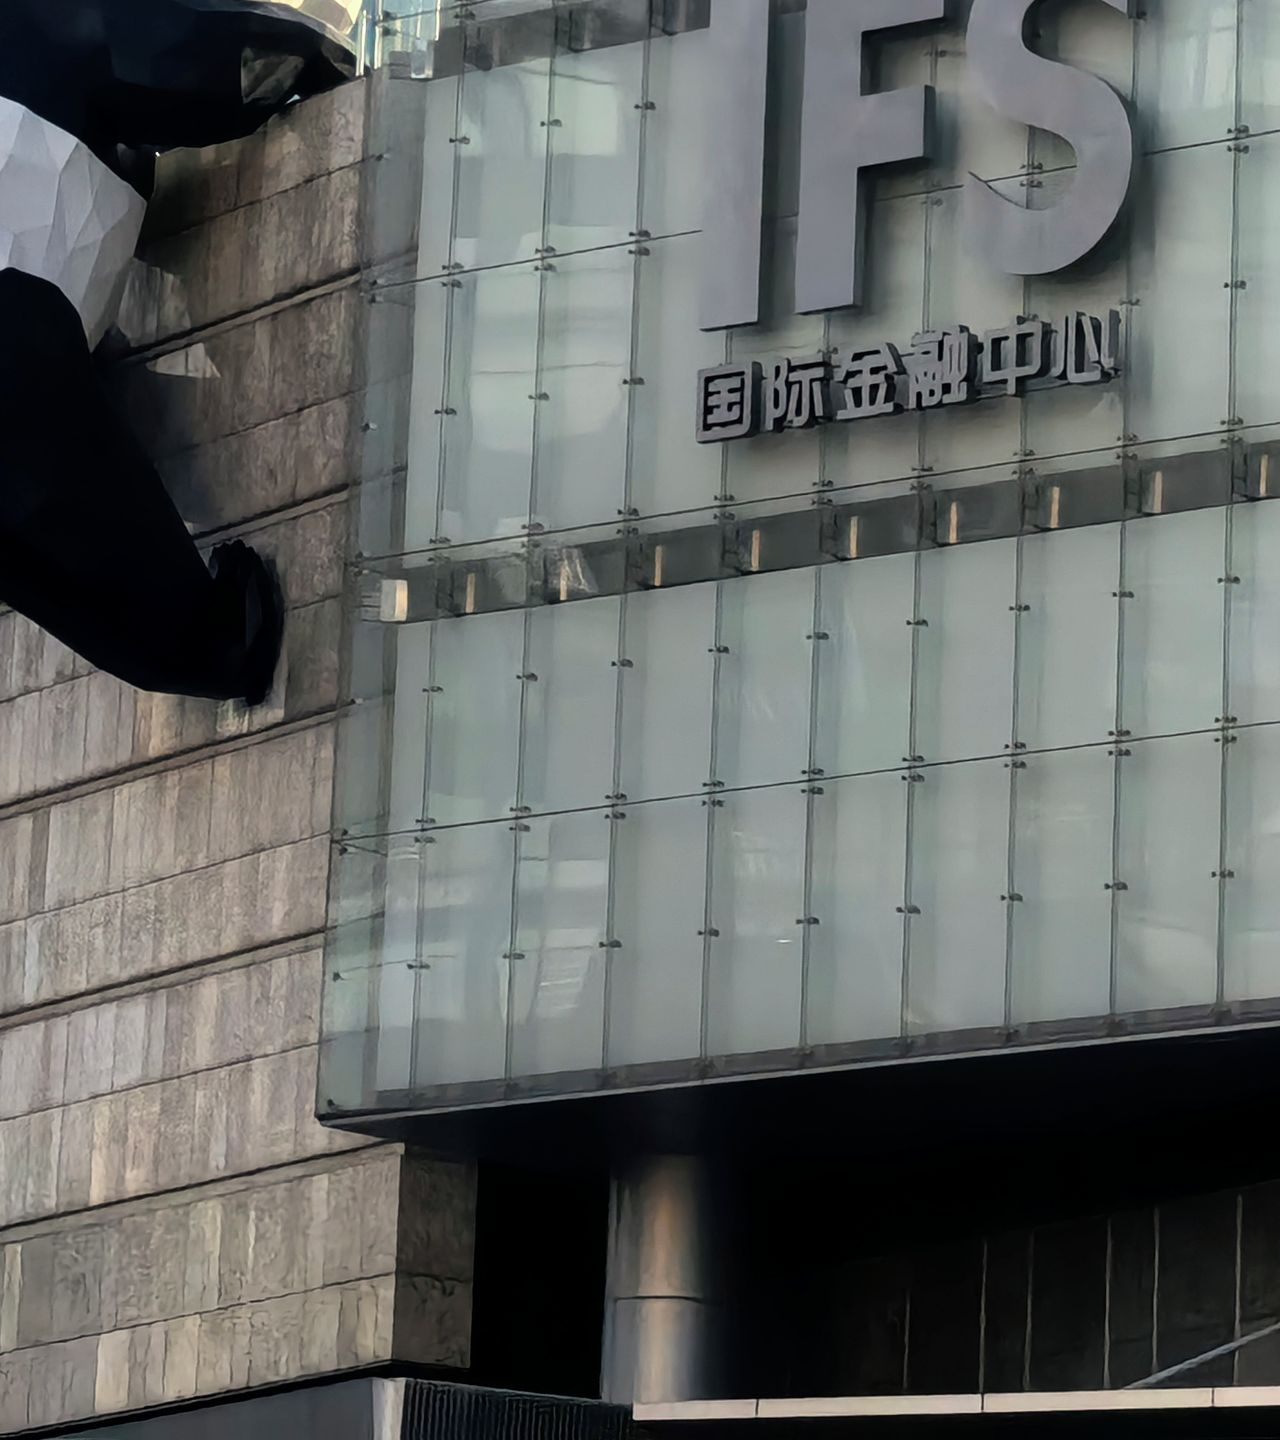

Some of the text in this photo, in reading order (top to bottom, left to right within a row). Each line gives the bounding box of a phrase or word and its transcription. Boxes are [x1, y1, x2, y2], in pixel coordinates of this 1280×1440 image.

[695, 308, 1121, 443] 国际金融中心
